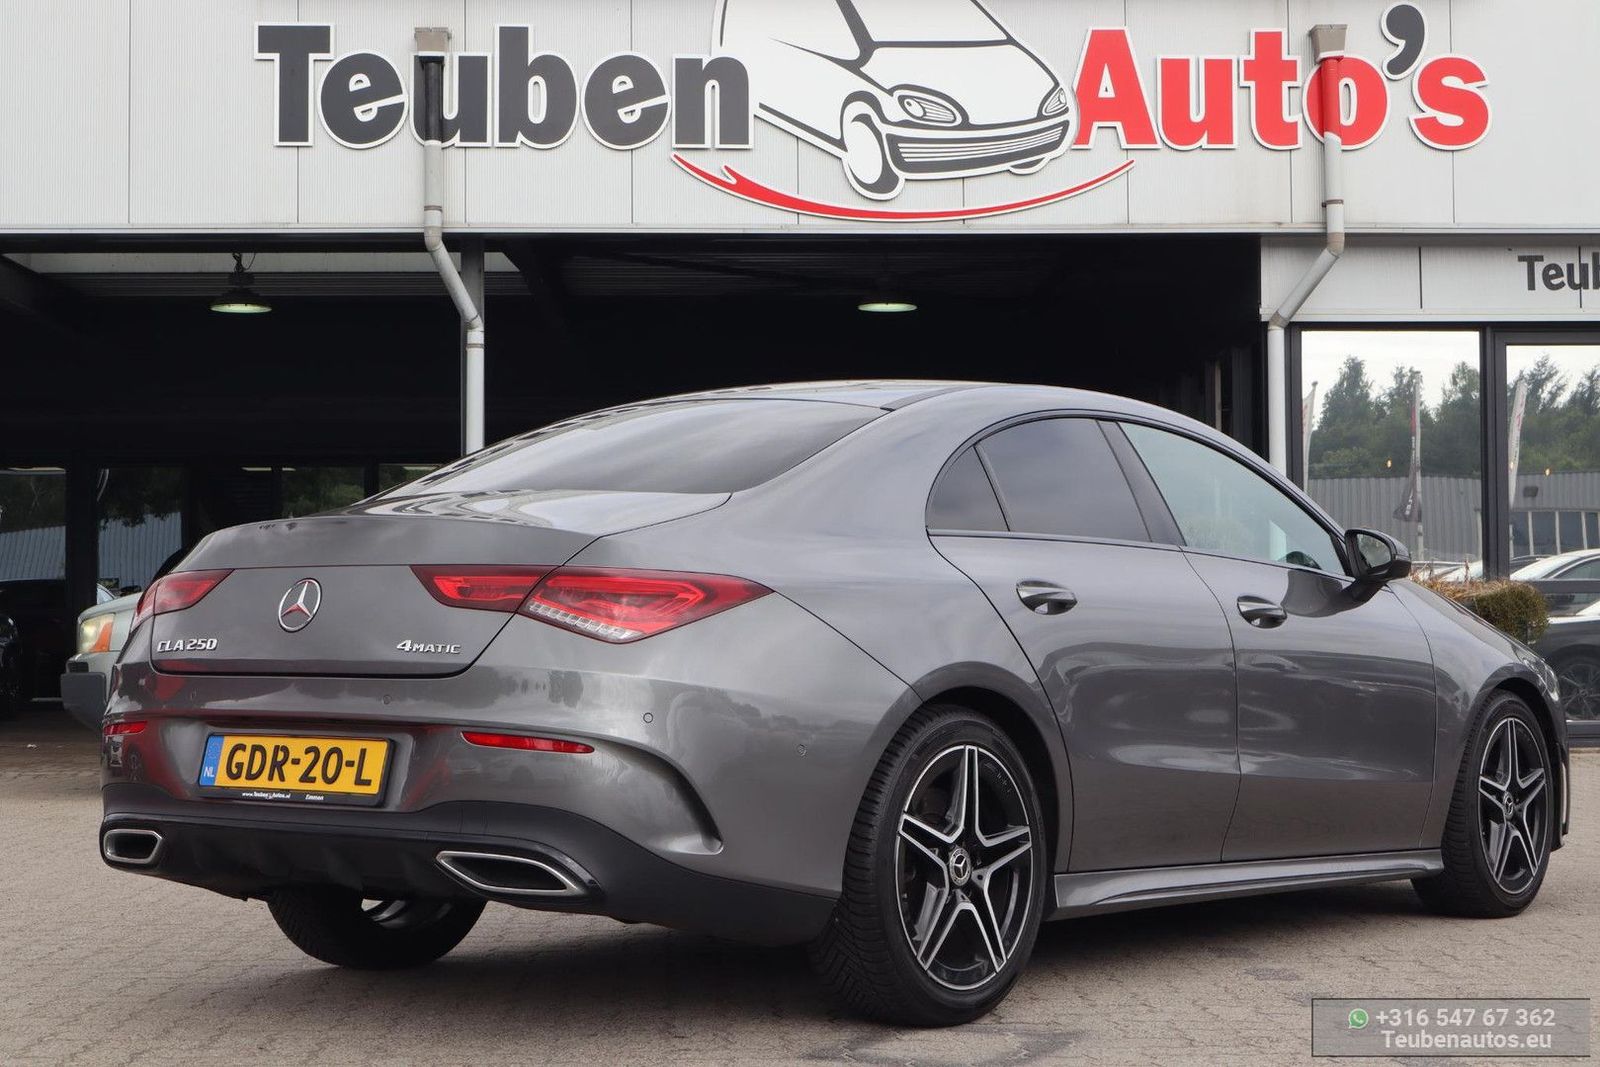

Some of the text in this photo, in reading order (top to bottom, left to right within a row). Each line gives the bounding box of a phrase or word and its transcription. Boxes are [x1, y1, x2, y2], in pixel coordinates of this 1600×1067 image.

[256, 4, 1489, 150] Teuben Auto's
[157, 638, 218, 653] CLA 250
[396, 640, 461, 654] 4MATIC
[203, 743, 372, 786] NL GDR-20-L
